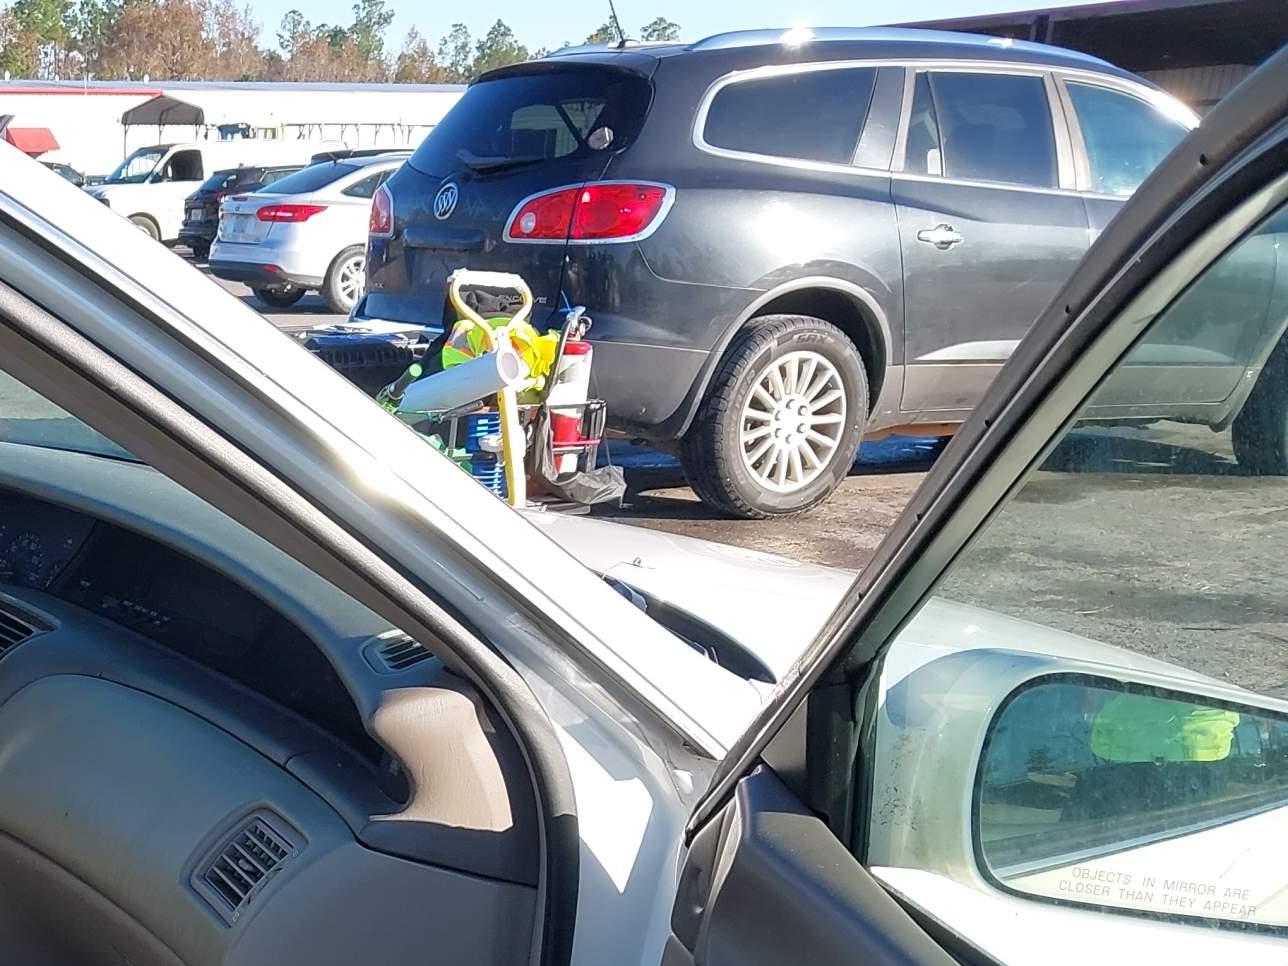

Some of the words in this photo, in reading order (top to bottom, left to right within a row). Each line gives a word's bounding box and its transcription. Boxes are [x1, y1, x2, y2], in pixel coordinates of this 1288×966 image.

[1058, 879, 1111, 897] CLOSER
[1119, 887, 1154, 903] THAN
[1162, 893, 1196, 909] THEY
[1202, 899, 1257, 918] APPEAR
[1071, 866, 1132, 886] OBJECTS
[1142, 875, 1156, 889] IN
[1162, 878, 1217, 897] MIRROR
[1223, 886, 1250, 901] ARE
